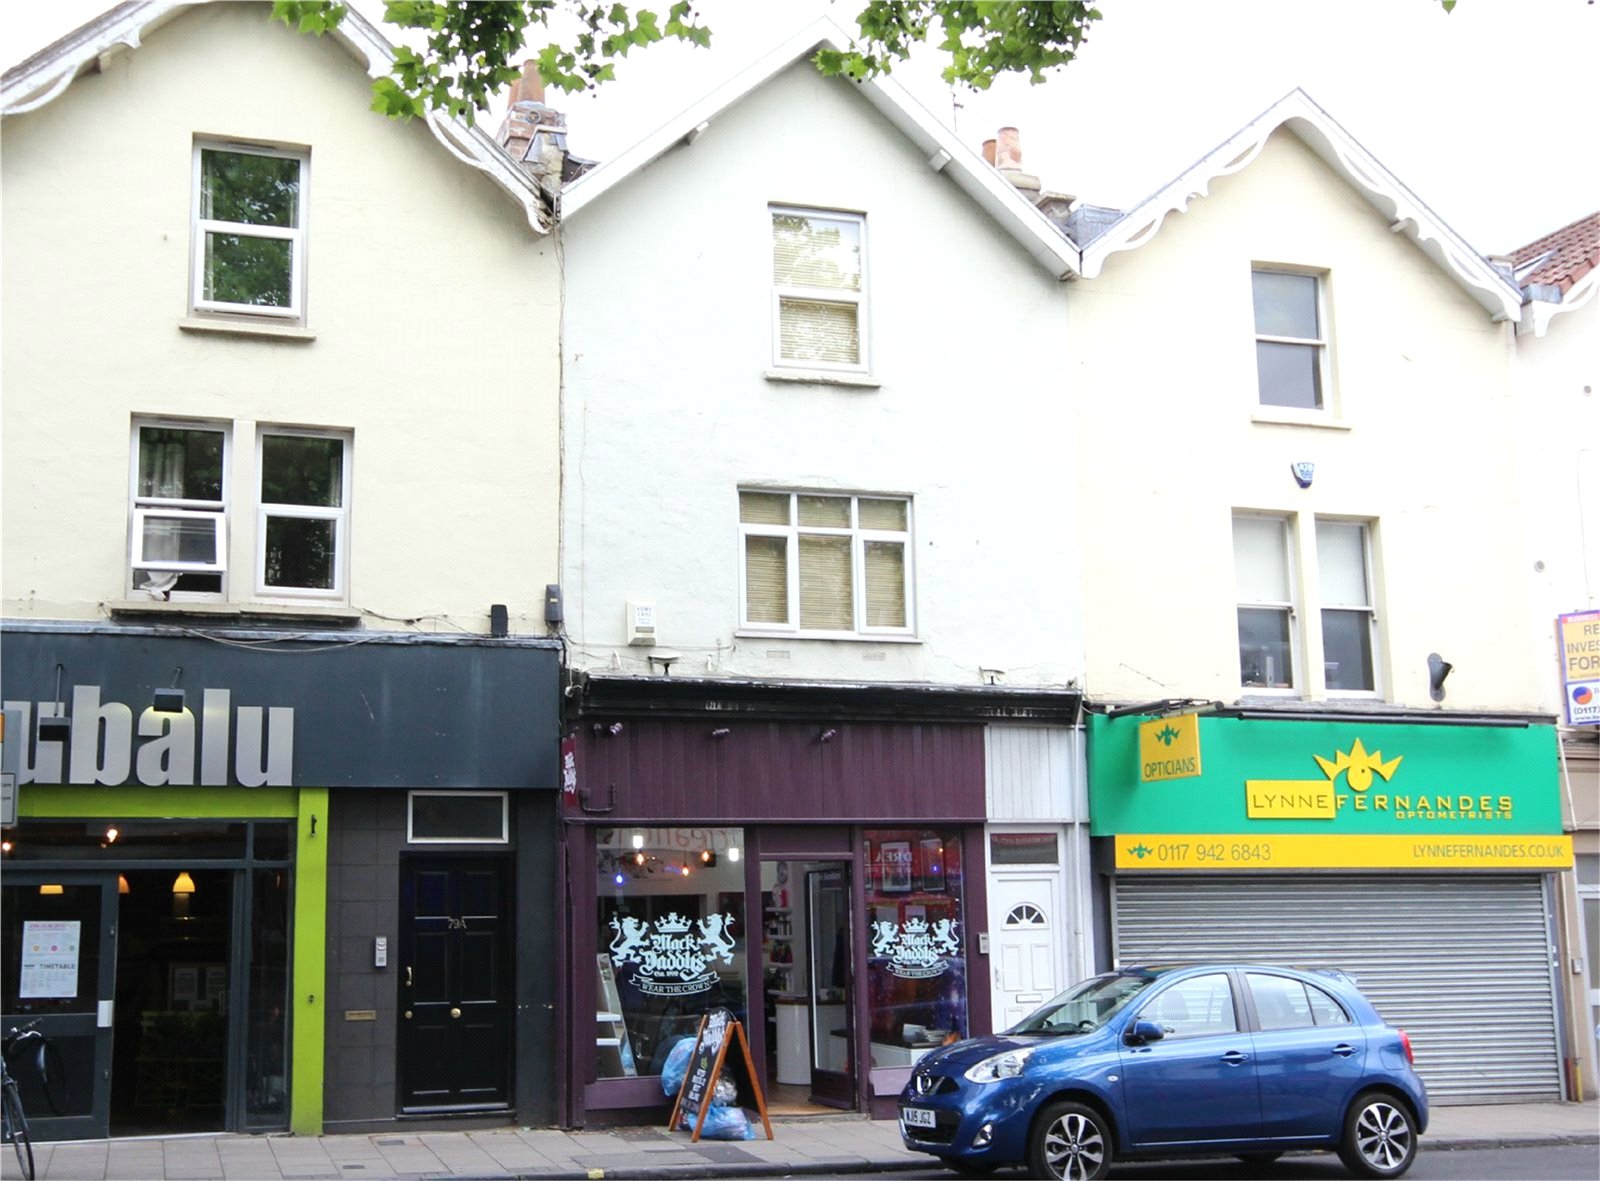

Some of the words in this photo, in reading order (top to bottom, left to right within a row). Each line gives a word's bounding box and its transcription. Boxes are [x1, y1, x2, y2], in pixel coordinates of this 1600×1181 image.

[1144, 757, 1195, 778] OPTICIANS
[1253, 794, 1329, 808] LYNNE
[1336, 794, 1513, 811] FERNANDES
[1395, 810, 1513, 820] OPTOMETRISTS
[1157, 843, 1190, 862] 0117
[1195, 843, 1225, 861] 942
[1231, 843, 1272, 861] 6843
[1413, 844, 1565, 859] LYNNEFERNANDES.CO.UK
[448, 918, 468, 929] 79A
[642, 982, 664, 993] WEAR
[665, 985, 682, 993] THE
[682, 980, 711, 992] CROWN
